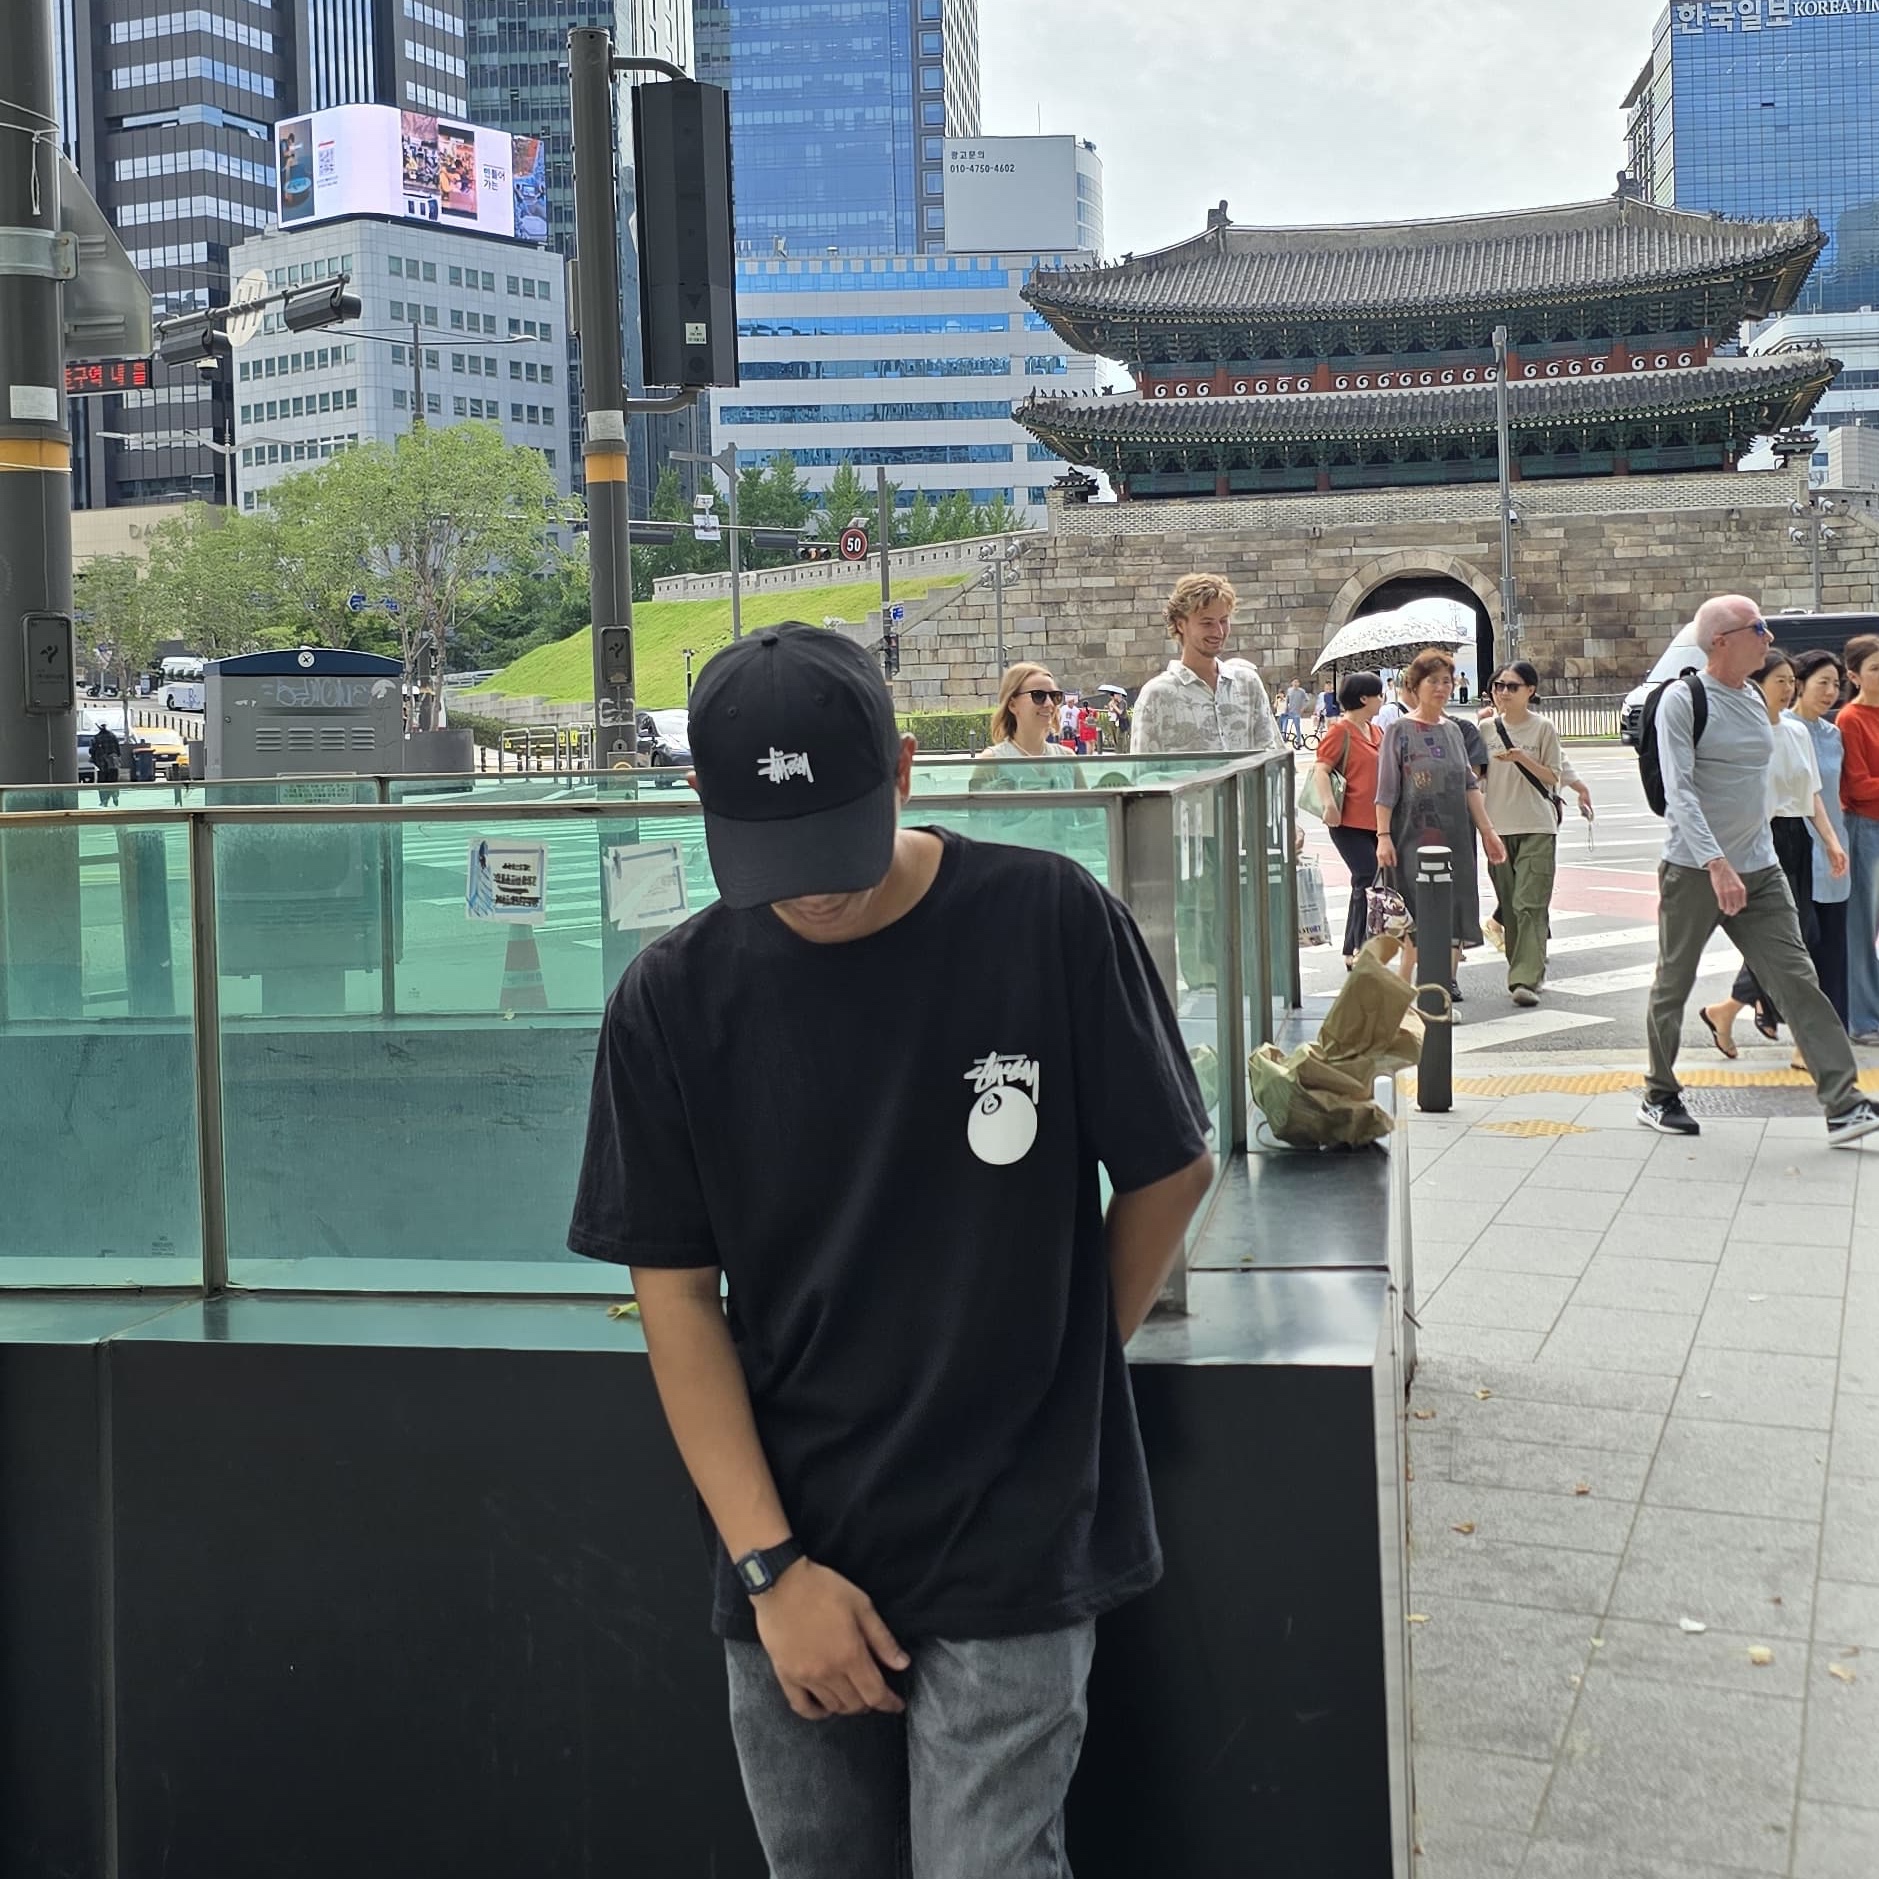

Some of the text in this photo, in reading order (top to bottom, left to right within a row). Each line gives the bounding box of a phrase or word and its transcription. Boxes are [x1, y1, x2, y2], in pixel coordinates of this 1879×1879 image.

[1792, 0, 1852, 17] KOREA
[1676, 0, 1793, 35] 한국일보
[951, 150, 985, 160] 광고문의
[950, 164, 1016, 173] 010-4750-4602
[846, 537, 861, 552] 50
